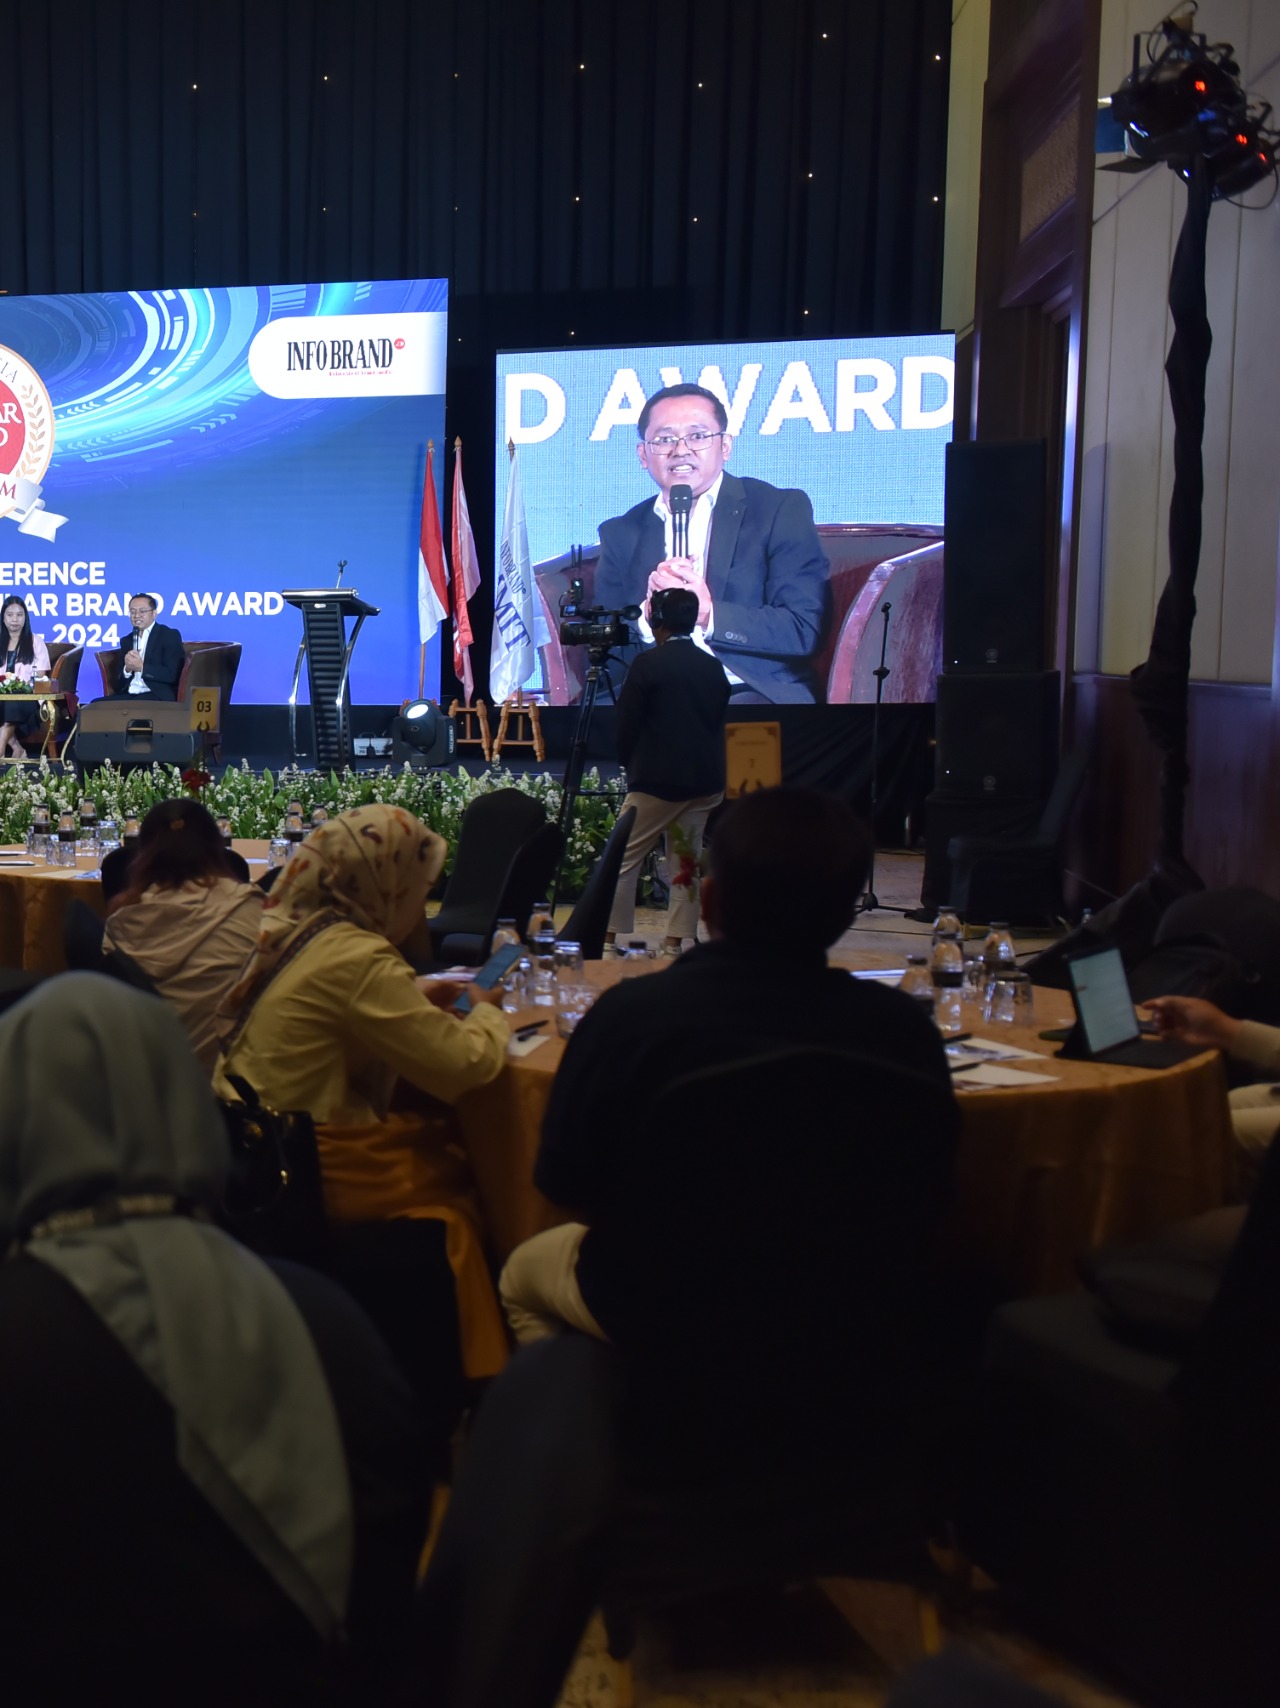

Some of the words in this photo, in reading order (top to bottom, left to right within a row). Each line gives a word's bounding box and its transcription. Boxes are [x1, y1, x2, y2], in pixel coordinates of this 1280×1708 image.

[505, 372, 566, 445] D
[588, 355, 955, 441] AWARD
[171, 591, 284, 616] AWARD
[52, 623, 120, 647] 2024
[196, 700, 212, 713] 03
